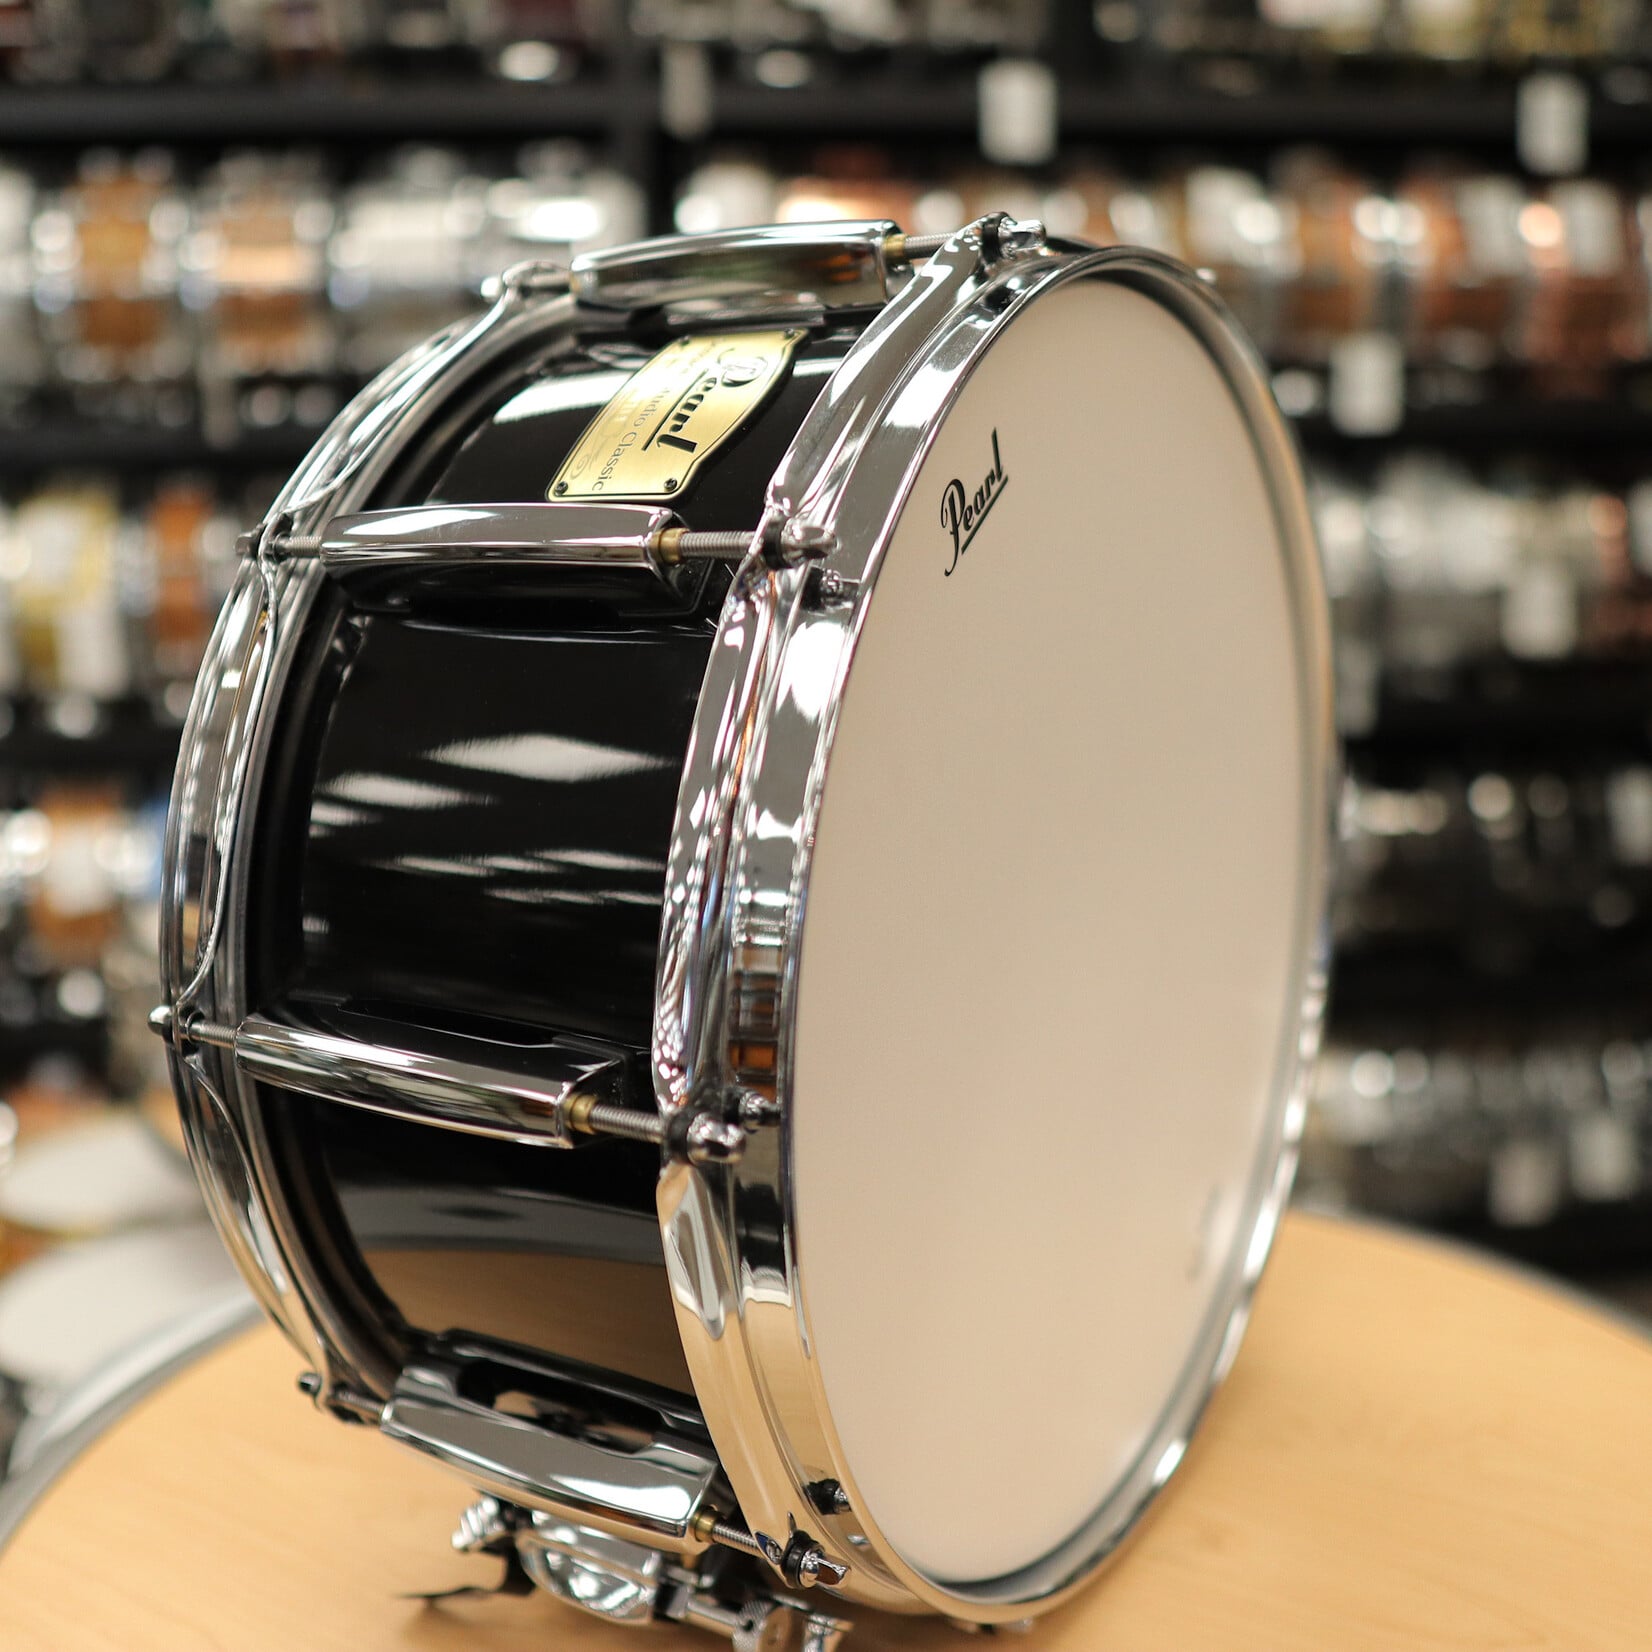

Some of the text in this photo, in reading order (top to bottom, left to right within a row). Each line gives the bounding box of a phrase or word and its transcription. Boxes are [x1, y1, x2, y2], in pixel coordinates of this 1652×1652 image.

[656, 347, 768, 453] Pearl
[592, 430, 637, 491] Classic
[940, 427, 1004, 577] Pearl
